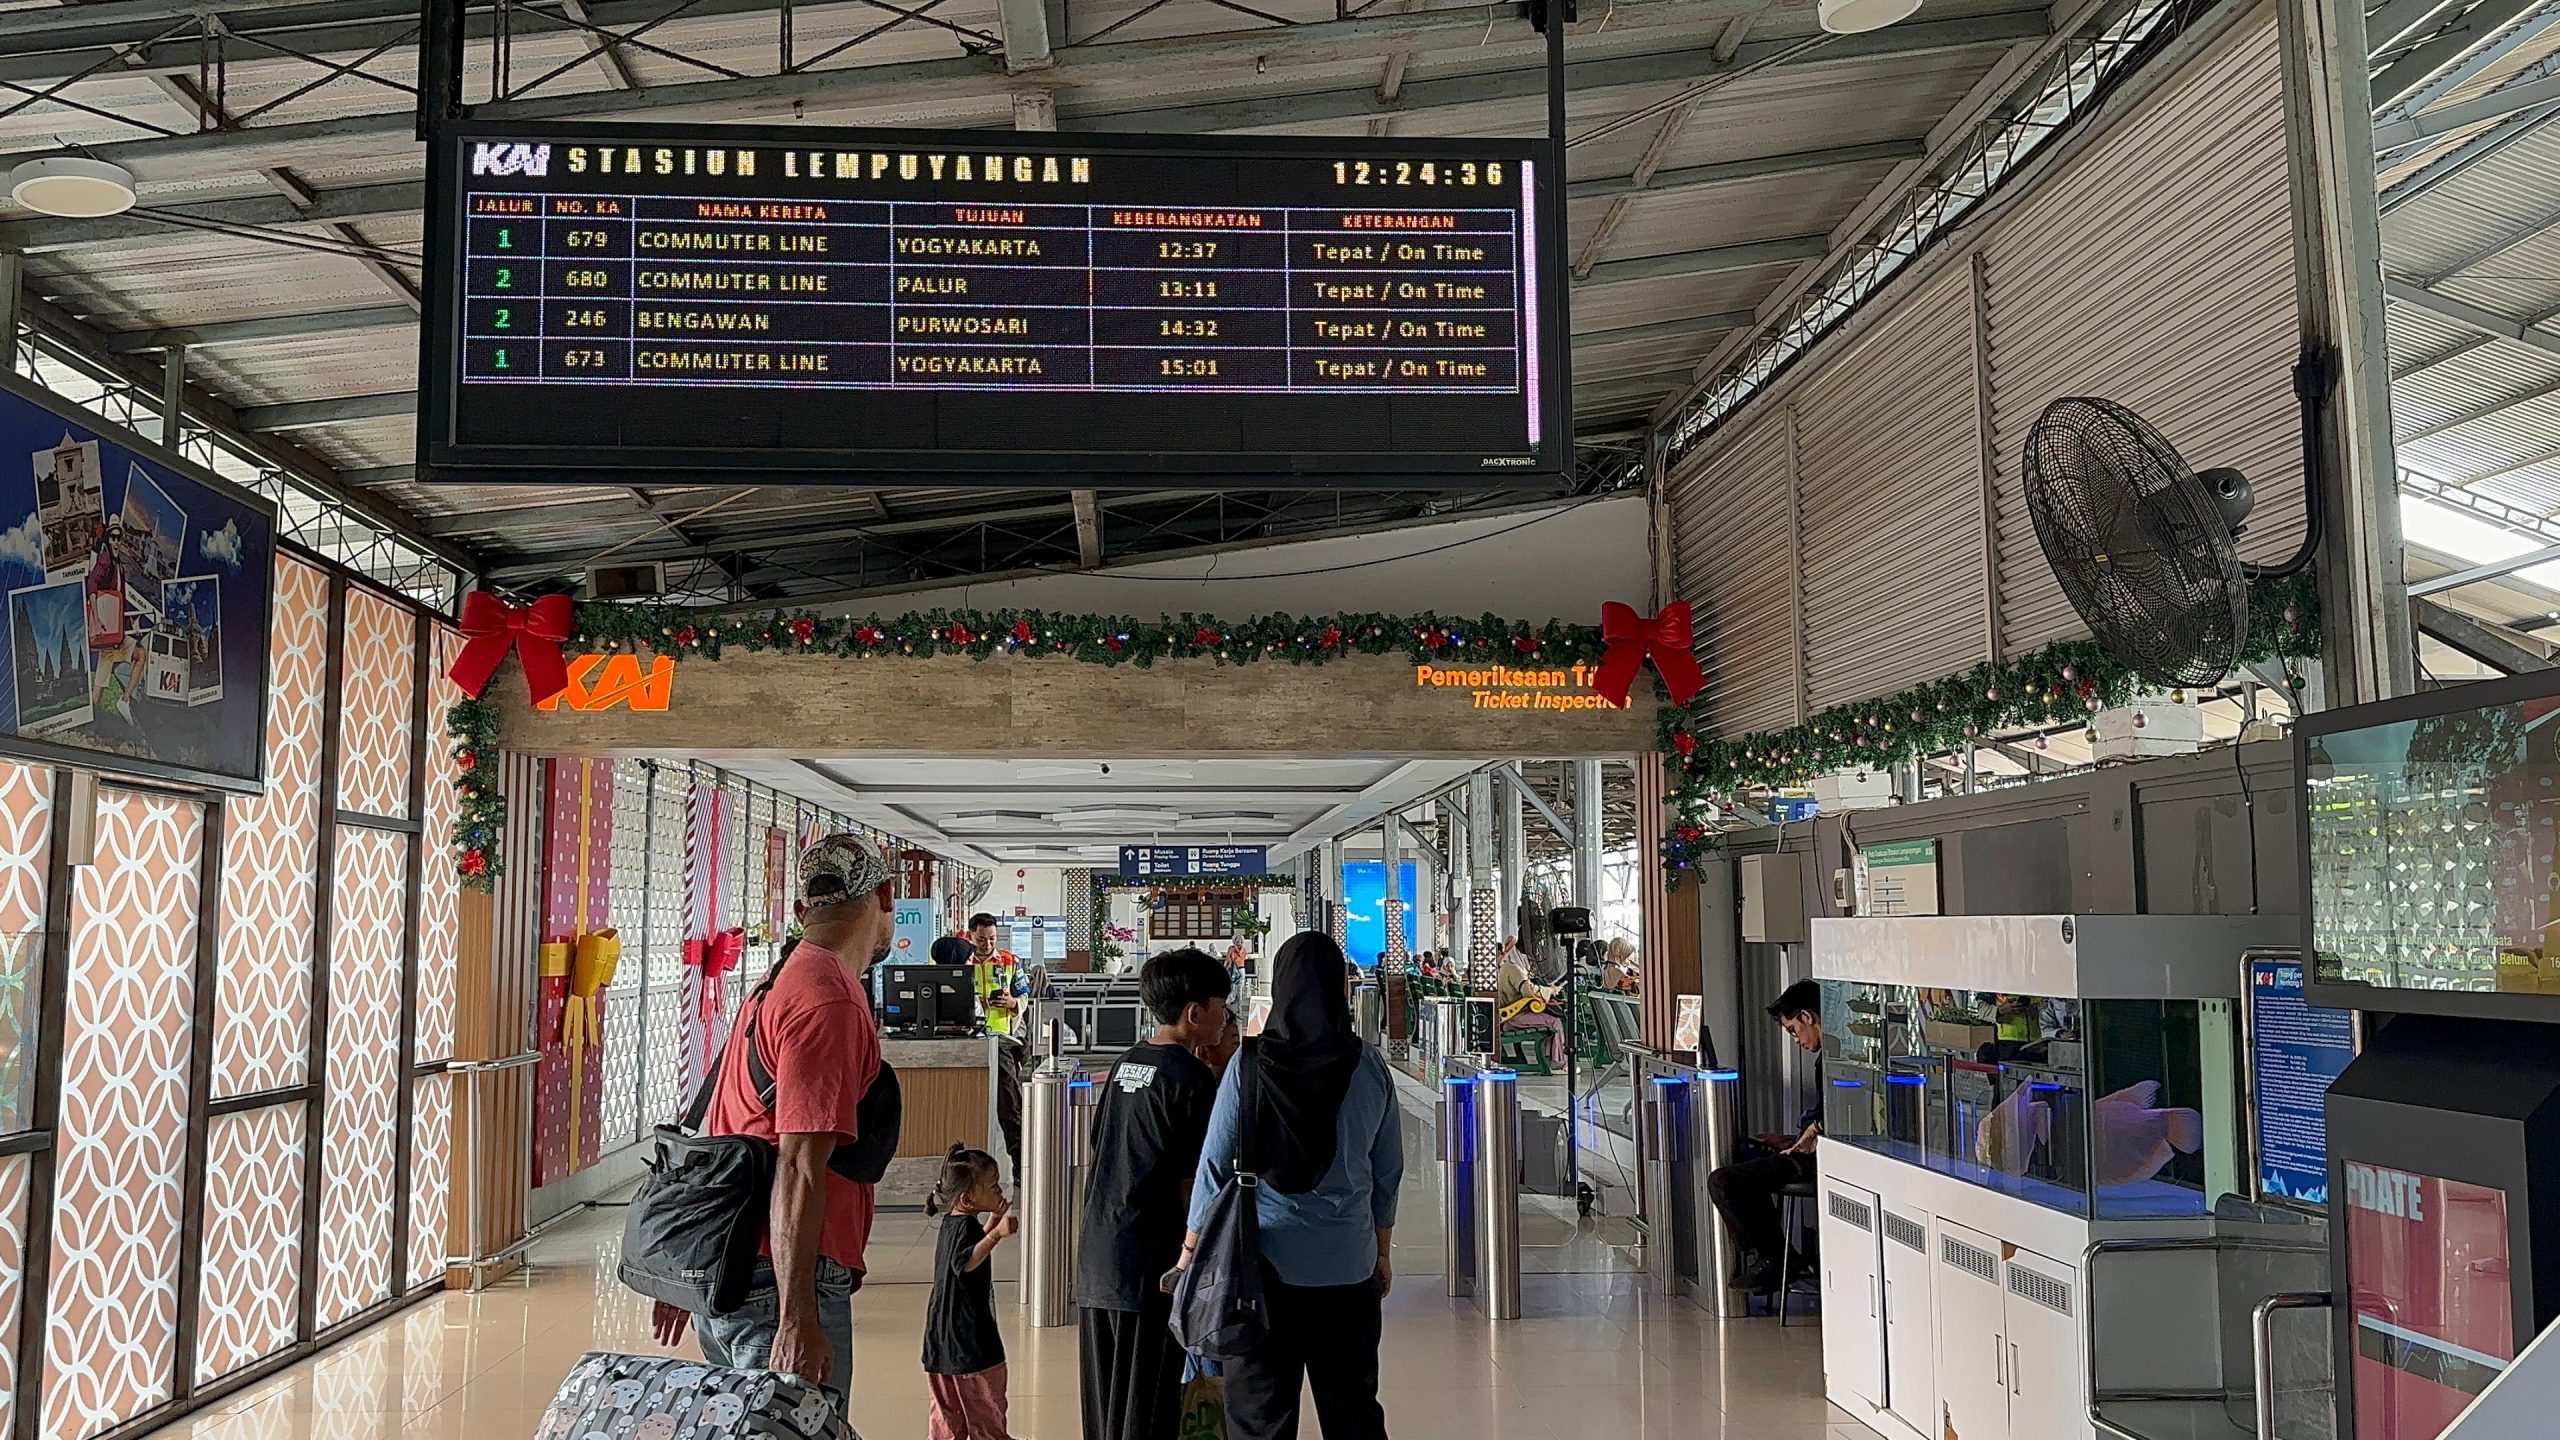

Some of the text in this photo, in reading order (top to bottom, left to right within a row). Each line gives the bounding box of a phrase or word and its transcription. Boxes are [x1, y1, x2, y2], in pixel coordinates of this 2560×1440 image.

[472, 143, 551, 176] KAI
[568, 147, 1089, 183] STASIUN LEMPUYANGAN
[1333, 161, 1503, 186] 12:24:36
[476, 199, 533, 213] JALUR
[556, 200, 621, 214] NO. KA
[698, 203, 827, 220] NAMA KERETA
[955, 208, 1025, 223] TUJUAN
[1113, 211, 1262, 227] KEBERANGKATAN
[1342, 214, 1455, 229] KETERANGAN
[499, 230, 512, 247] 1
[568, 231, 608, 247] 679
[638, 232, 828, 252] COMMUTER LINE
[898, 238, 1041, 255] YOGYAKARTA
[1160, 243, 1217, 259] 12:37
[1313, 243, 1484, 264] Tepat / On Time
[496, 270, 512, 287] 2
[566, 271, 608, 288] 680
[638, 272, 828, 292] COMMUTER LINE
[898, 277, 968, 294] PALUR
[1160, 282, 1217, 298] 13:11
[1314, 282, 1485, 302] Tepat / On Time
[495, 310, 511, 328] 2
[565, 310, 607, 327] 246
[638, 312, 769, 330] BENGAWAN
[898, 317, 1028, 334] PURWOSARI
[1161, 320, 1218, 336] 14:32
[1314, 320, 1486, 341] Tepat / On Time
[496, 350, 509, 368] 1
[564, 351, 606, 367] 673
[638, 352, 829, 372] COMMUTER LINE
[898, 357, 1043, 374] YOGYAKARTA
[1161, 360, 1219, 376] 15:01
[1315, 359, 1487, 380] Tepat / On Time
[159, 670, 181, 693] KAI
[537, 654, 675, 711] KAI
[1417, 665, 1599, 687] Pemeriksaan Ti
[1472, 691, 1529, 709] Ticket
[2449, 934, 2480, 948] Tempat
[2483, 934, 2513, 947] Wisata
[2500, 953, 2530, 966] Belum
